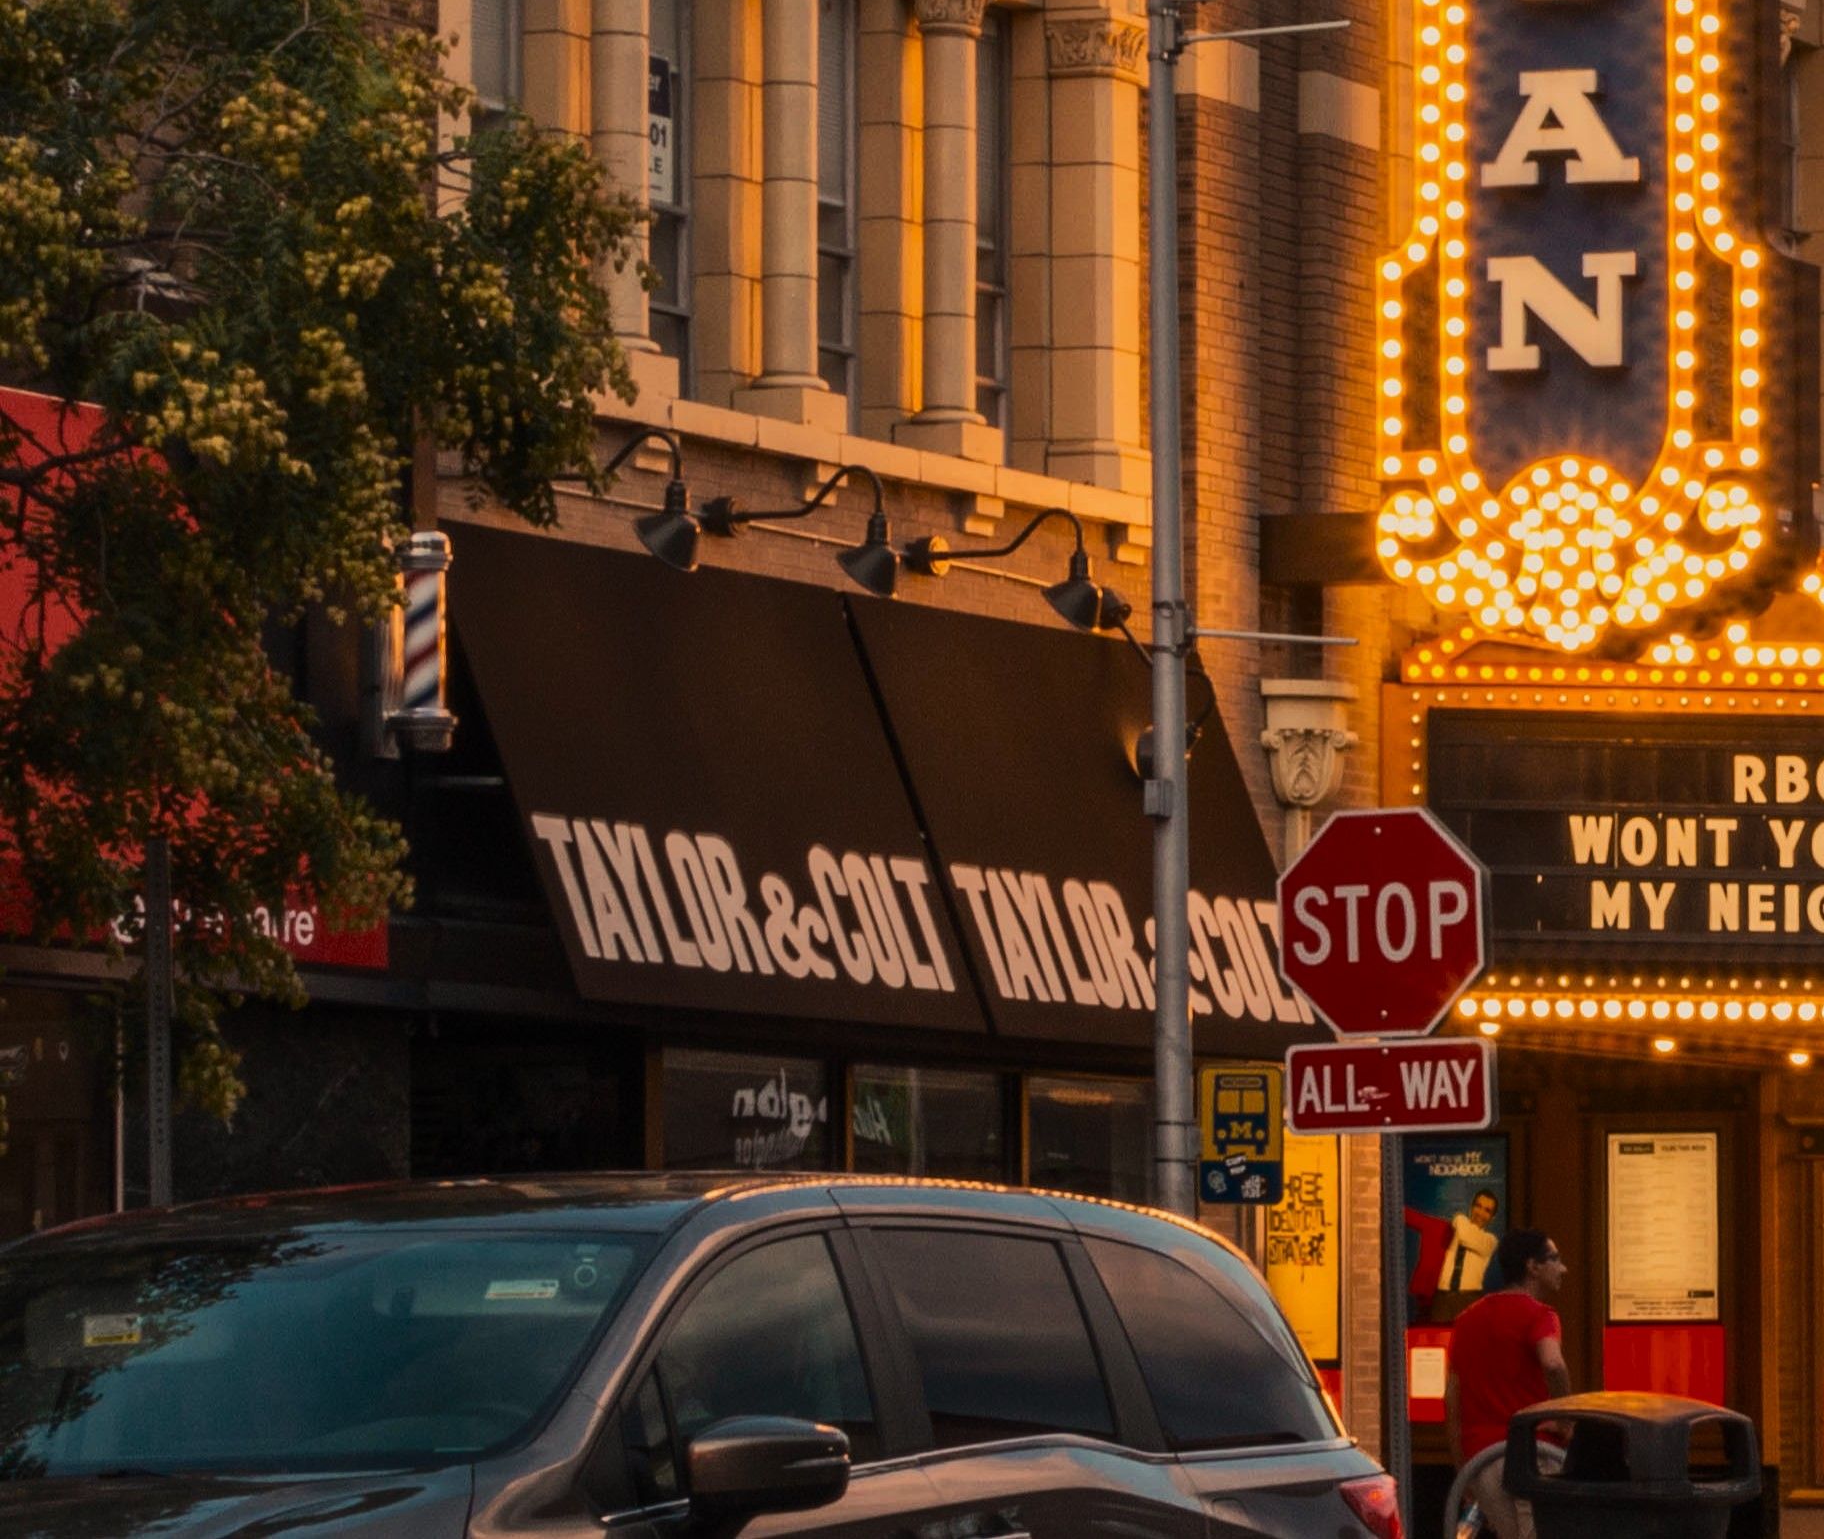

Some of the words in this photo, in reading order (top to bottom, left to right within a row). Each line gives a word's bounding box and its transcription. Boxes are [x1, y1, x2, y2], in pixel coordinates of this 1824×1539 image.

[1568, 814, 1738, 867] WONT
[531, 812, 955, 993] TAYLOR&COLT
[1292, 880, 1469, 966] STOP
[1591, 879, 1677, 931] MY
[1298, 1062, 1371, 1115] ALL
[1400, 1059, 1477, 1110] WAY
[1229, 1121, 1252, 1139] M
